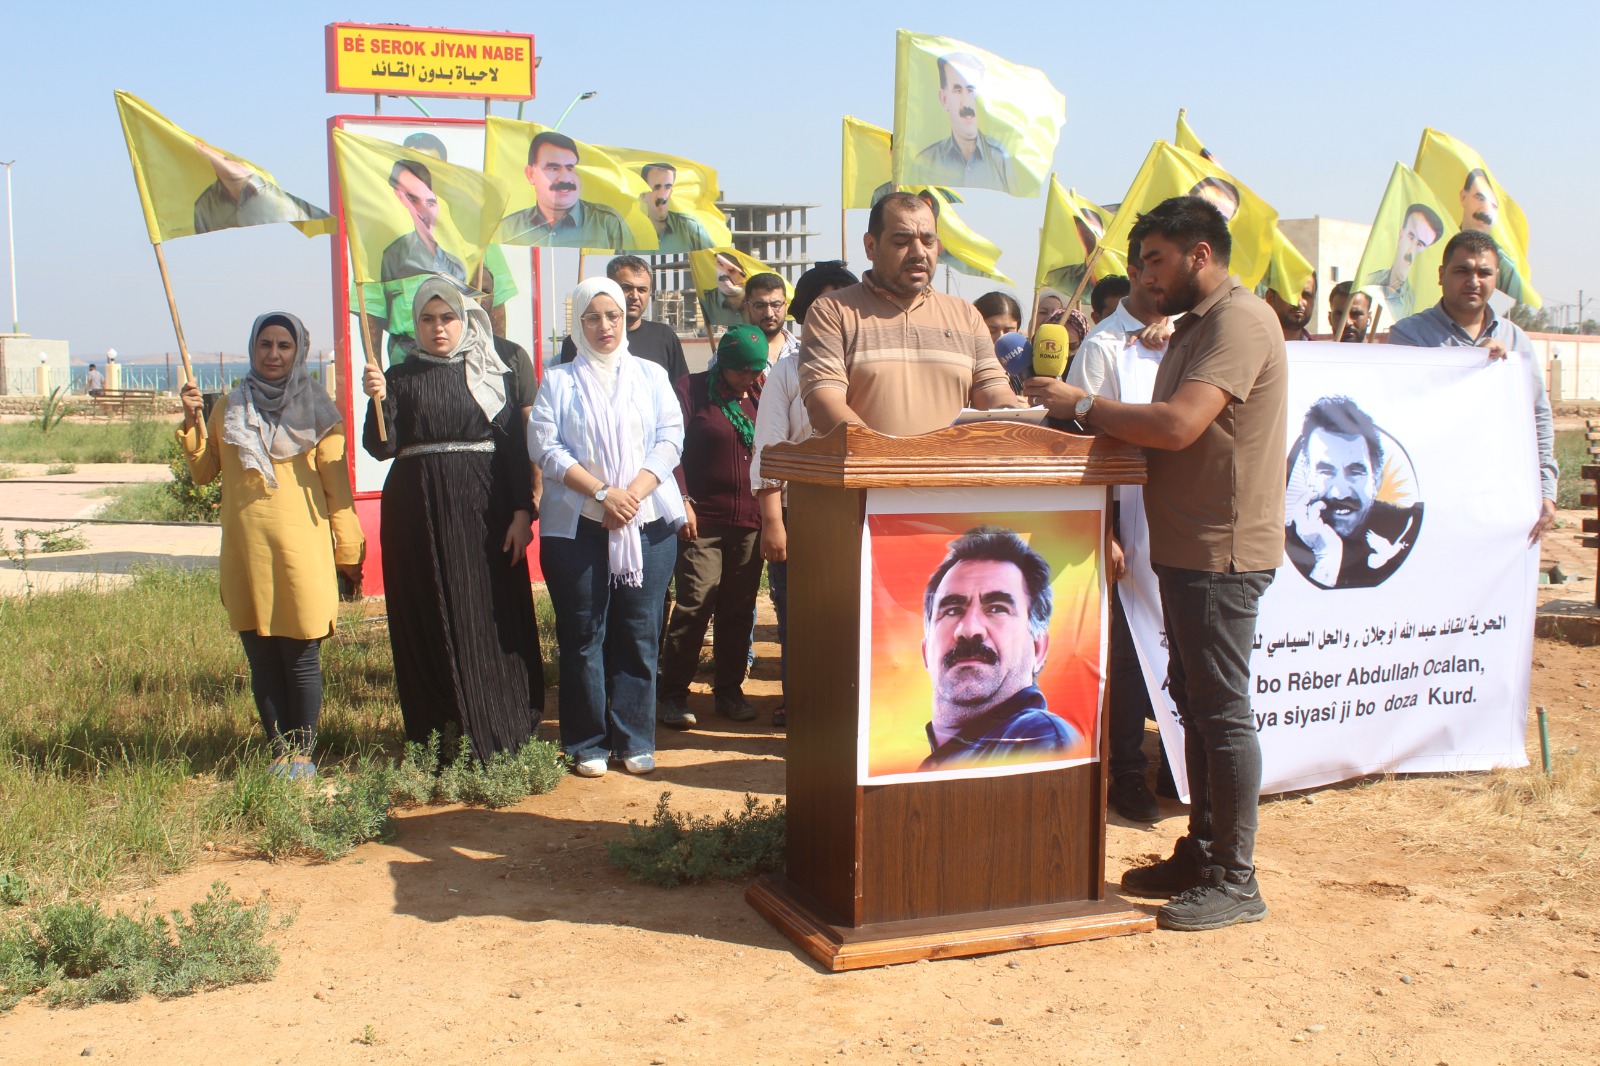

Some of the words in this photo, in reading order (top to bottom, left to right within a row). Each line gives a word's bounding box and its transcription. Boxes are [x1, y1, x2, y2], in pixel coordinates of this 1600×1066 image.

[344, 34, 365, 53] BÊ
[370, 38, 426, 56] SEROK
[482, 45, 524, 61] NABE
[371, 60, 415, 77] القائد
[418, 65, 454, 85] بدون
[1362, 620, 1398, 648] أوجلان
[1399, 620, 1416, 639] الله
[1417, 623, 1437, 642] عبد
[1439, 617, 1467, 636] للقائد
[1468, 614, 1507, 637] الحرية
[1266, 629, 1315, 658] السياسي
[1317, 627, 1350, 650] والحل
[1256, 674, 1282, 694] bo
[1287, 670, 1342, 692] Rêber
[1346, 661, 1419, 687] Abdullah
[1423, 655, 1485, 677] Ocalan,
[1283, 701, 1338, 729] siyasî
[1339, 700, 1352, 724] ji
[1355, 699, 1376, 717] bo
[1384, 694, 1418, 713] doza
[1428, 686, 1477, 706] Kurd.
